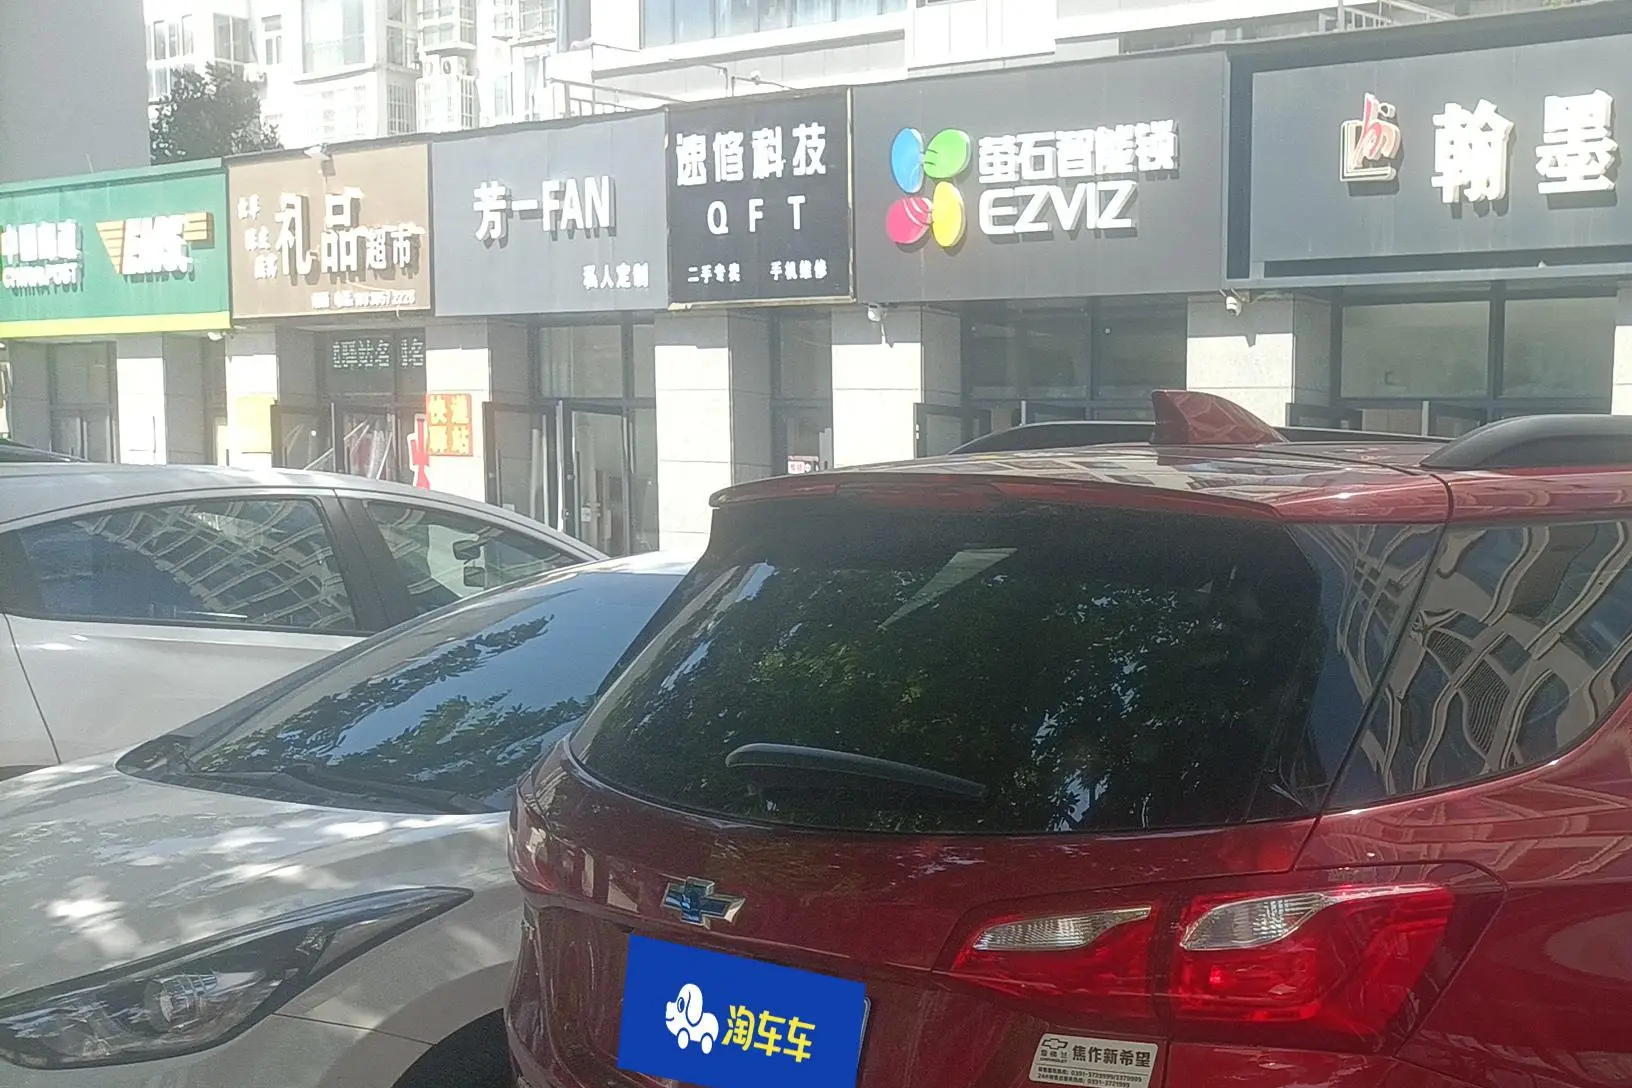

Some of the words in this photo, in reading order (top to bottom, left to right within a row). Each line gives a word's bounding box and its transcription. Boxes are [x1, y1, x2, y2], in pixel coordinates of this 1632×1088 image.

[978, 179, 1138, 235] EZVIZ
[1072, 1044, 1151, 1068] 焦作新希望
